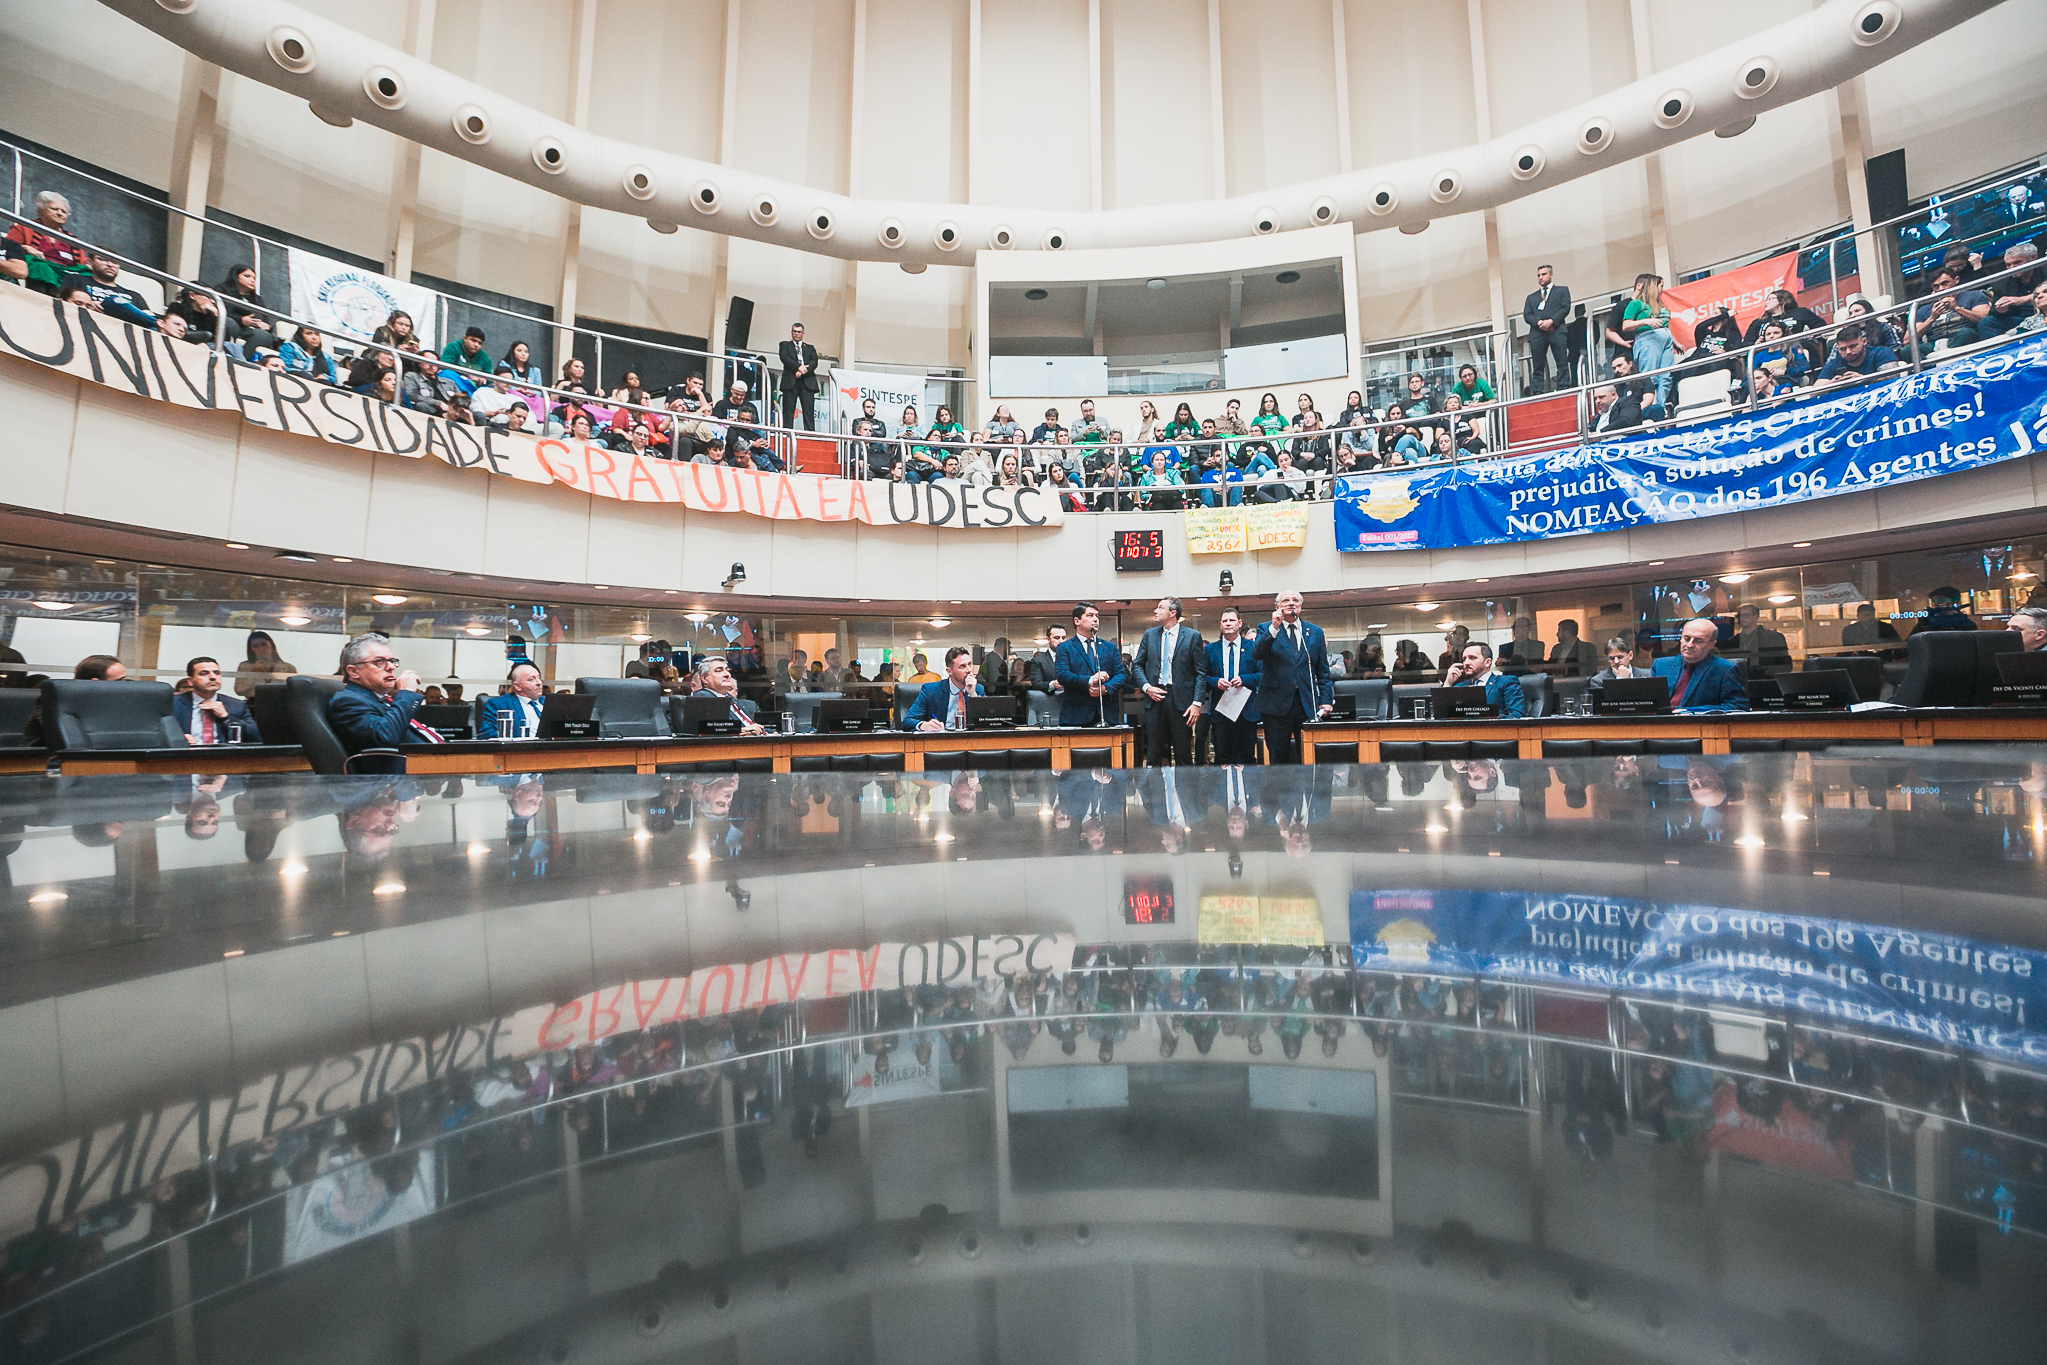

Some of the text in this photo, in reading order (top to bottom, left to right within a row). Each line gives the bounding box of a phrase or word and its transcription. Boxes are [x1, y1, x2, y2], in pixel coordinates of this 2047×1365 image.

[860, 387, 918, 405] SINTESPE
[0, 298, 512, 476] UNIVERSIDADE
[888, 481, 1047, 528] UDESC
[1476, 464, 1537, 482] Falta
[1585, 418, 1752, 465] POLICIAIS
[1509, 391, 1986, 511] prejudica a solução de crimes!
[1506, 490, 1695, 535] NOMEAÇÃO
[1705, 485, 1761, 510] dos
[1769, 468, 1828, 499] 196
[1837, 436, 1997, 486] Agentes
[1252, 503, 1300, 513] UNIVERSIDADE
[1220, 524, 1240, 533] UDESC
[1258, 532, 1296, 545] UDESC
[1362, 532, 1415, 542] Edital 001/2022
[1889, 610, 1929, 620] 00:00:00
